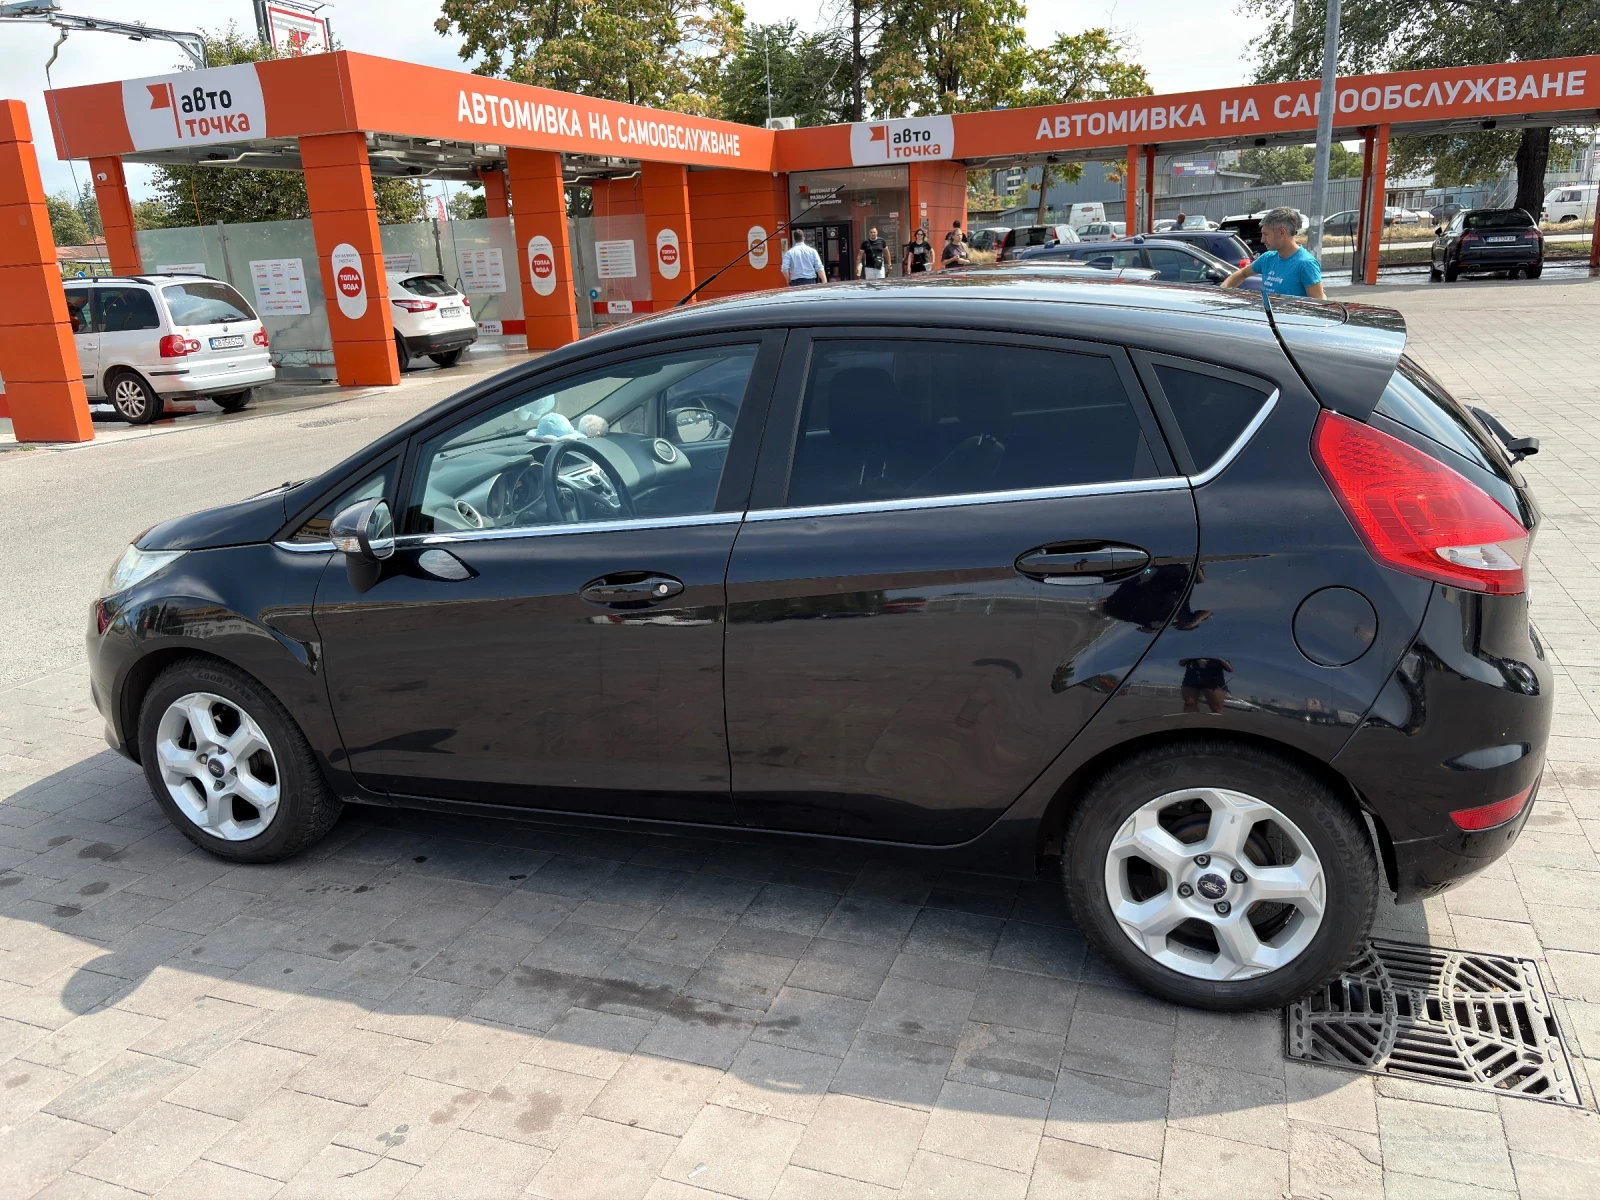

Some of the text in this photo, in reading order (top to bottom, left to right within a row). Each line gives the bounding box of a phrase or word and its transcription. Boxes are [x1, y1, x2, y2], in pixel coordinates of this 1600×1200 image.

[181, 87, 232, 113] авто
[185, 113, 250, 137] точка
[458, 90, 740, 157] АВТОМИВКА НА САМООБСЛУЖВАНЕ
[1035, 103, 1206, 140] АВТОМИВКА
[1219, 98, 1260, 124] НА
[893, 128, 931, 144] авто
[893, 143, 941, 158] точка
[342, 283, 359, 291] ВОДА
